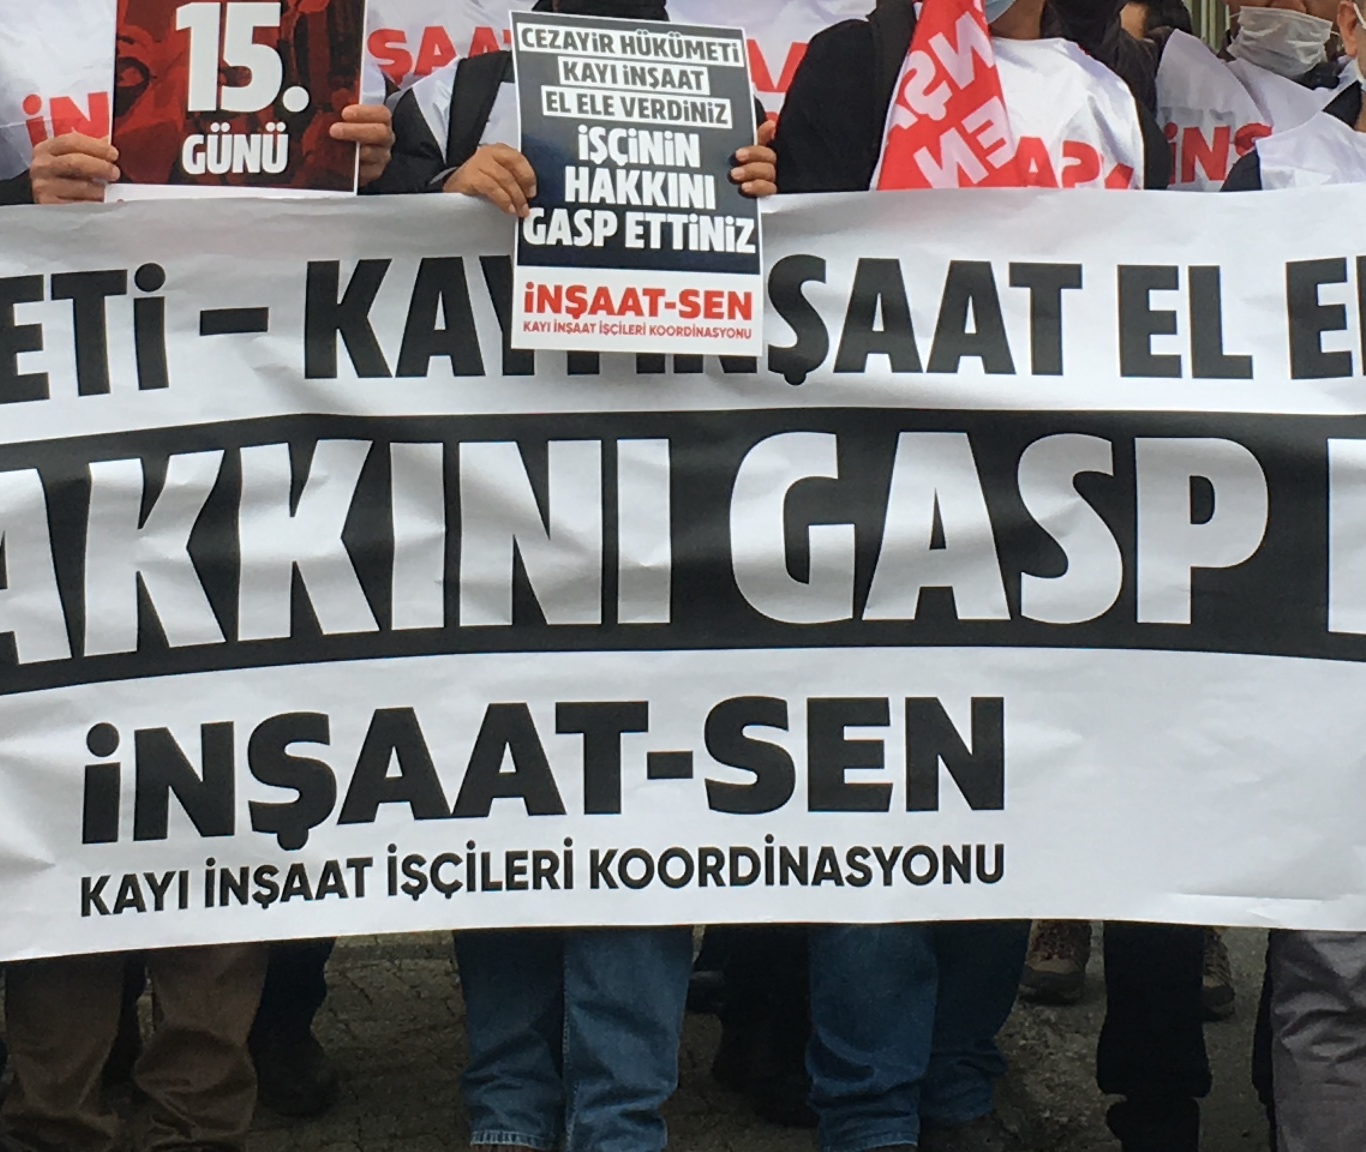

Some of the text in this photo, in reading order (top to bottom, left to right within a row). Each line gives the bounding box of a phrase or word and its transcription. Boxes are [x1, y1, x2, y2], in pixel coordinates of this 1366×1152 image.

[175, 3, 310, 112] 15.
[563, 61, 616, 85] KAYI
[545, 91, 570, 113] EL
[577, 94, 614, 116] ELE
[183, 122, 288, 175] GÜNÜ
[565, 166, 716, 210] HAKKINI
[522, 207, 618, 247] GASP
[523, 321, 551, 332] KAYI
[1118, 264, 1253, 379] EL
[729, 431, 1269, 624] GASP
[80, 870, 188, 917] KAYI
